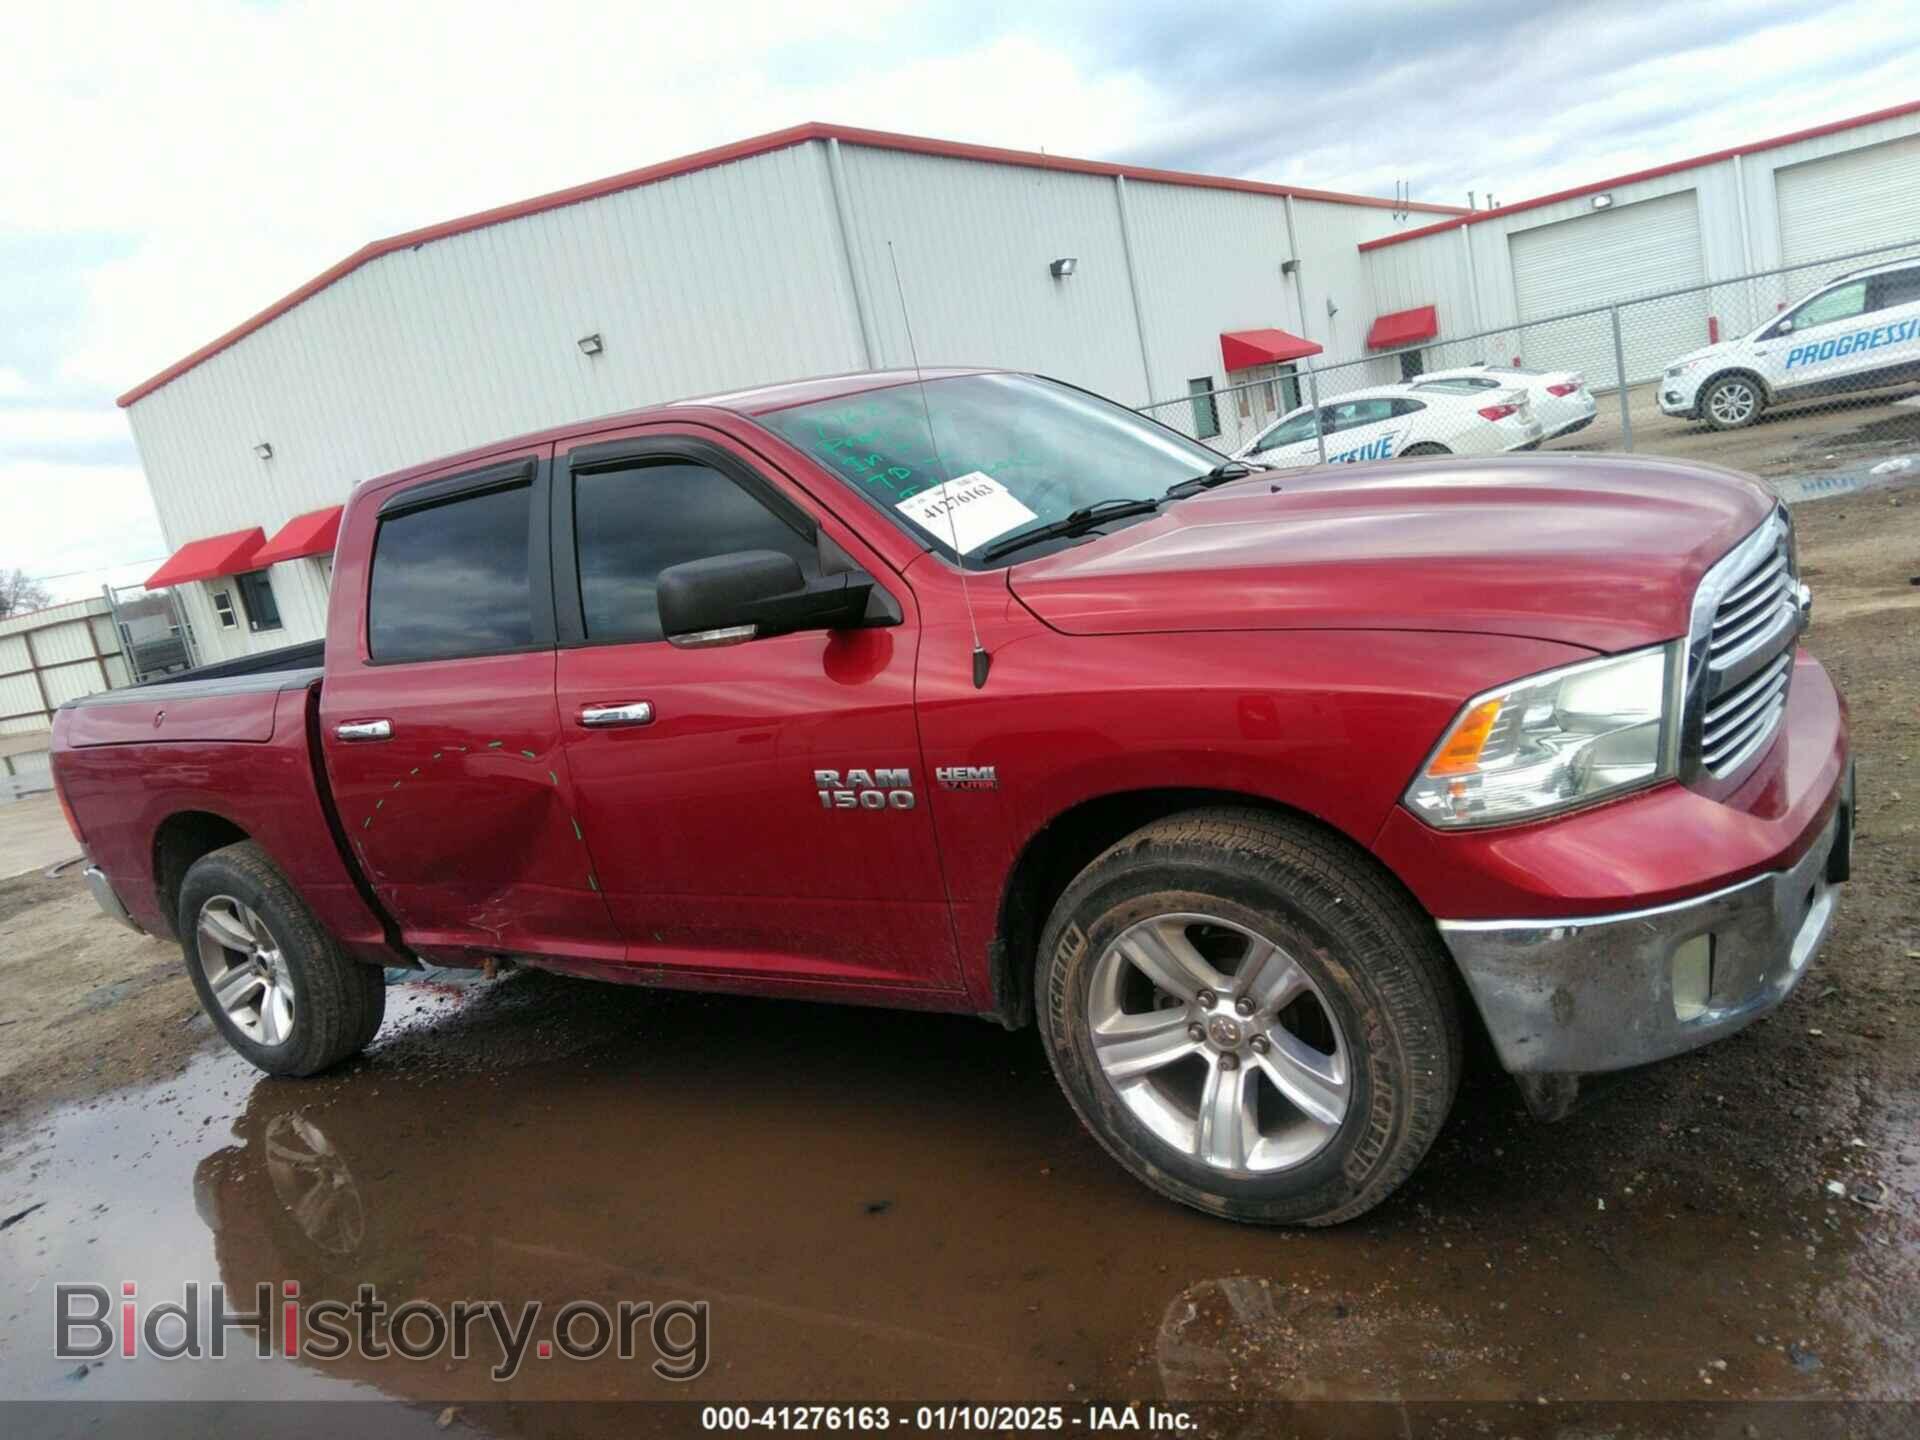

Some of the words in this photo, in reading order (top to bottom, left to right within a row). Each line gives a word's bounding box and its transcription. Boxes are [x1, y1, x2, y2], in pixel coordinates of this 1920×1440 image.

[1785, 318, 1920, 368] PROGRESSI
[923, 483, 994, 519] 41276163
[813, 768, 912, 788] RAM
[935, 766, 996, 780] HEMI
[818, 790, 915, 809] 1500
[1048, 921, 1089, 1042] MICHELIN
